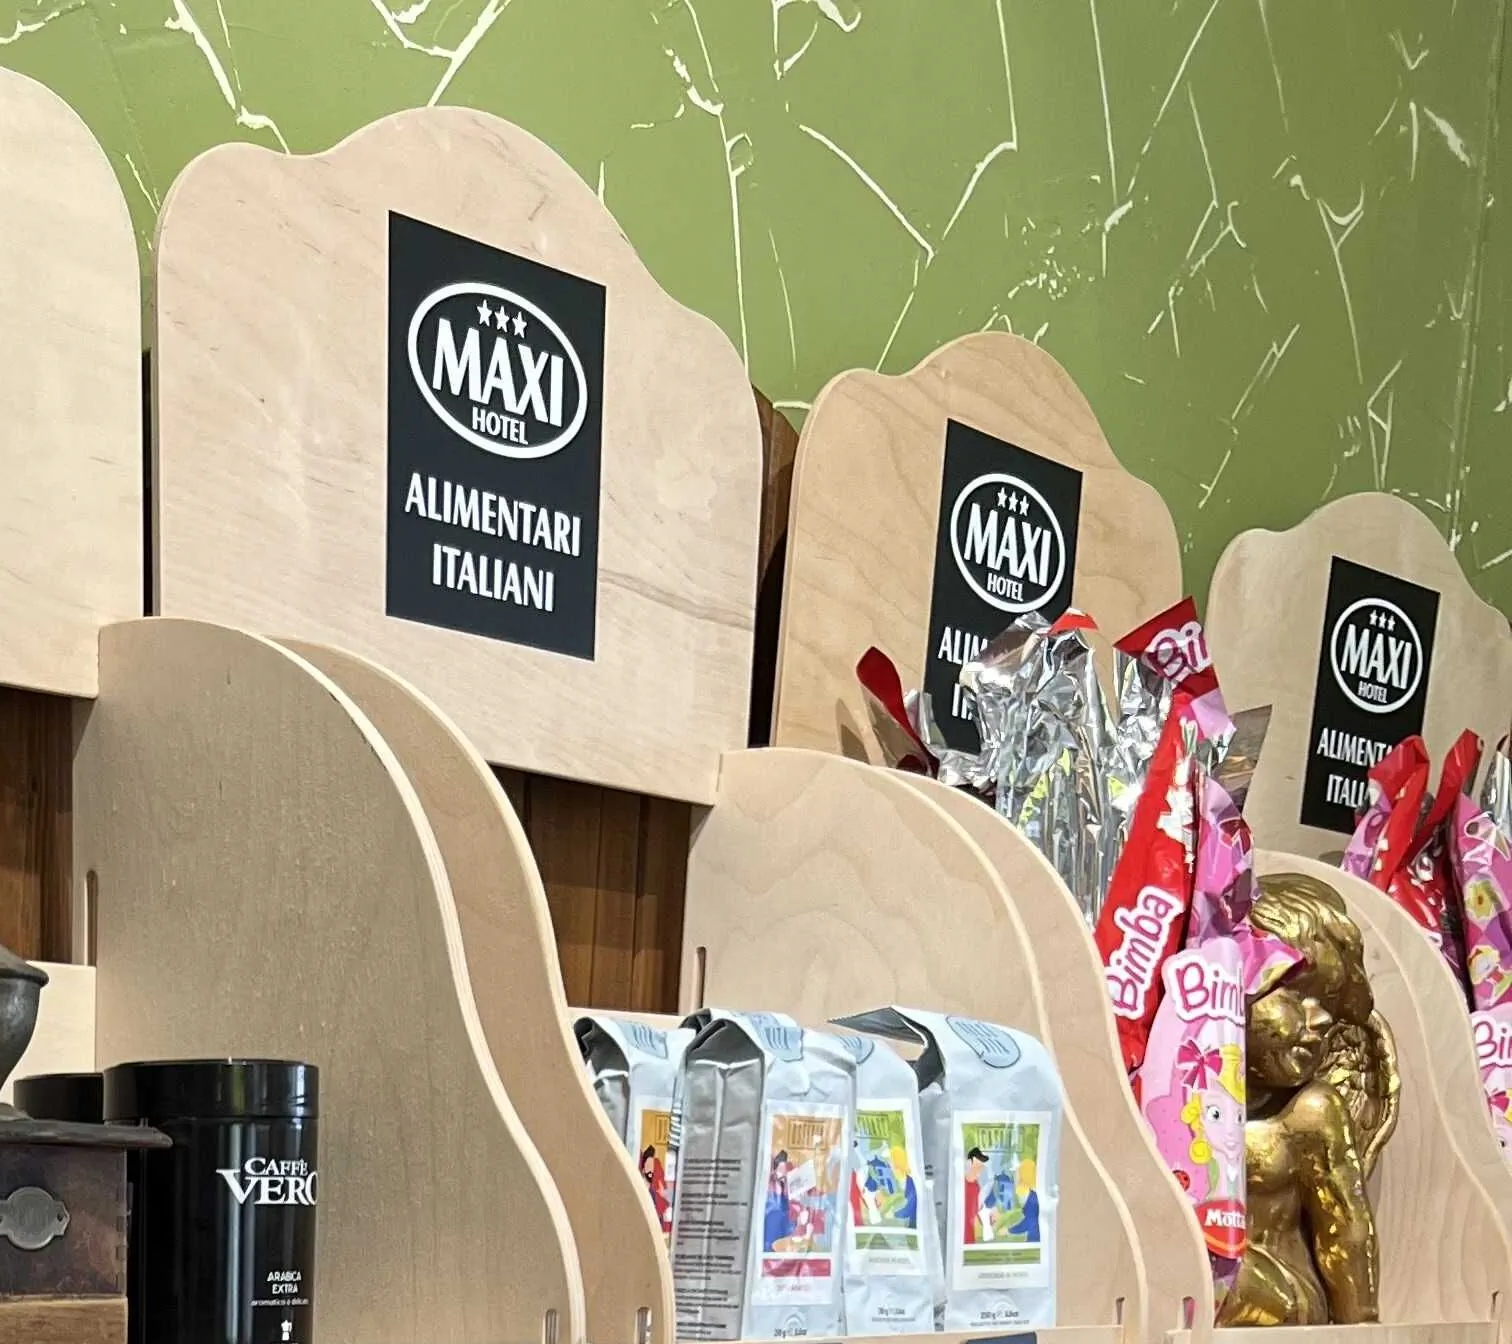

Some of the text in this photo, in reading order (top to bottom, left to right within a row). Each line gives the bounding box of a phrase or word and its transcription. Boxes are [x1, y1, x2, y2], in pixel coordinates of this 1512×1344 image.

[432, 318, 564, 427] MAXI
[472, 406, 528, 445] HOTEL
[405, 472, 581, 557] ALIMENTARI
[964, 503, 1051, 586] MAXI
[433, 543, 554, 612] ITALIANI
[987, 573, 1024, 602] HOTEL
[1340, 624, 1413, 689] MAXI
[1357, 680, 1388, 703] HOTEL
[1317, 727, 1392, 767] ALIMENT
[1106, 894, 1174, 1012] Bimba
[244, 1157, 309, 1176] CAFFÈ
[272, 1283, 298, 1294] EXTRA
